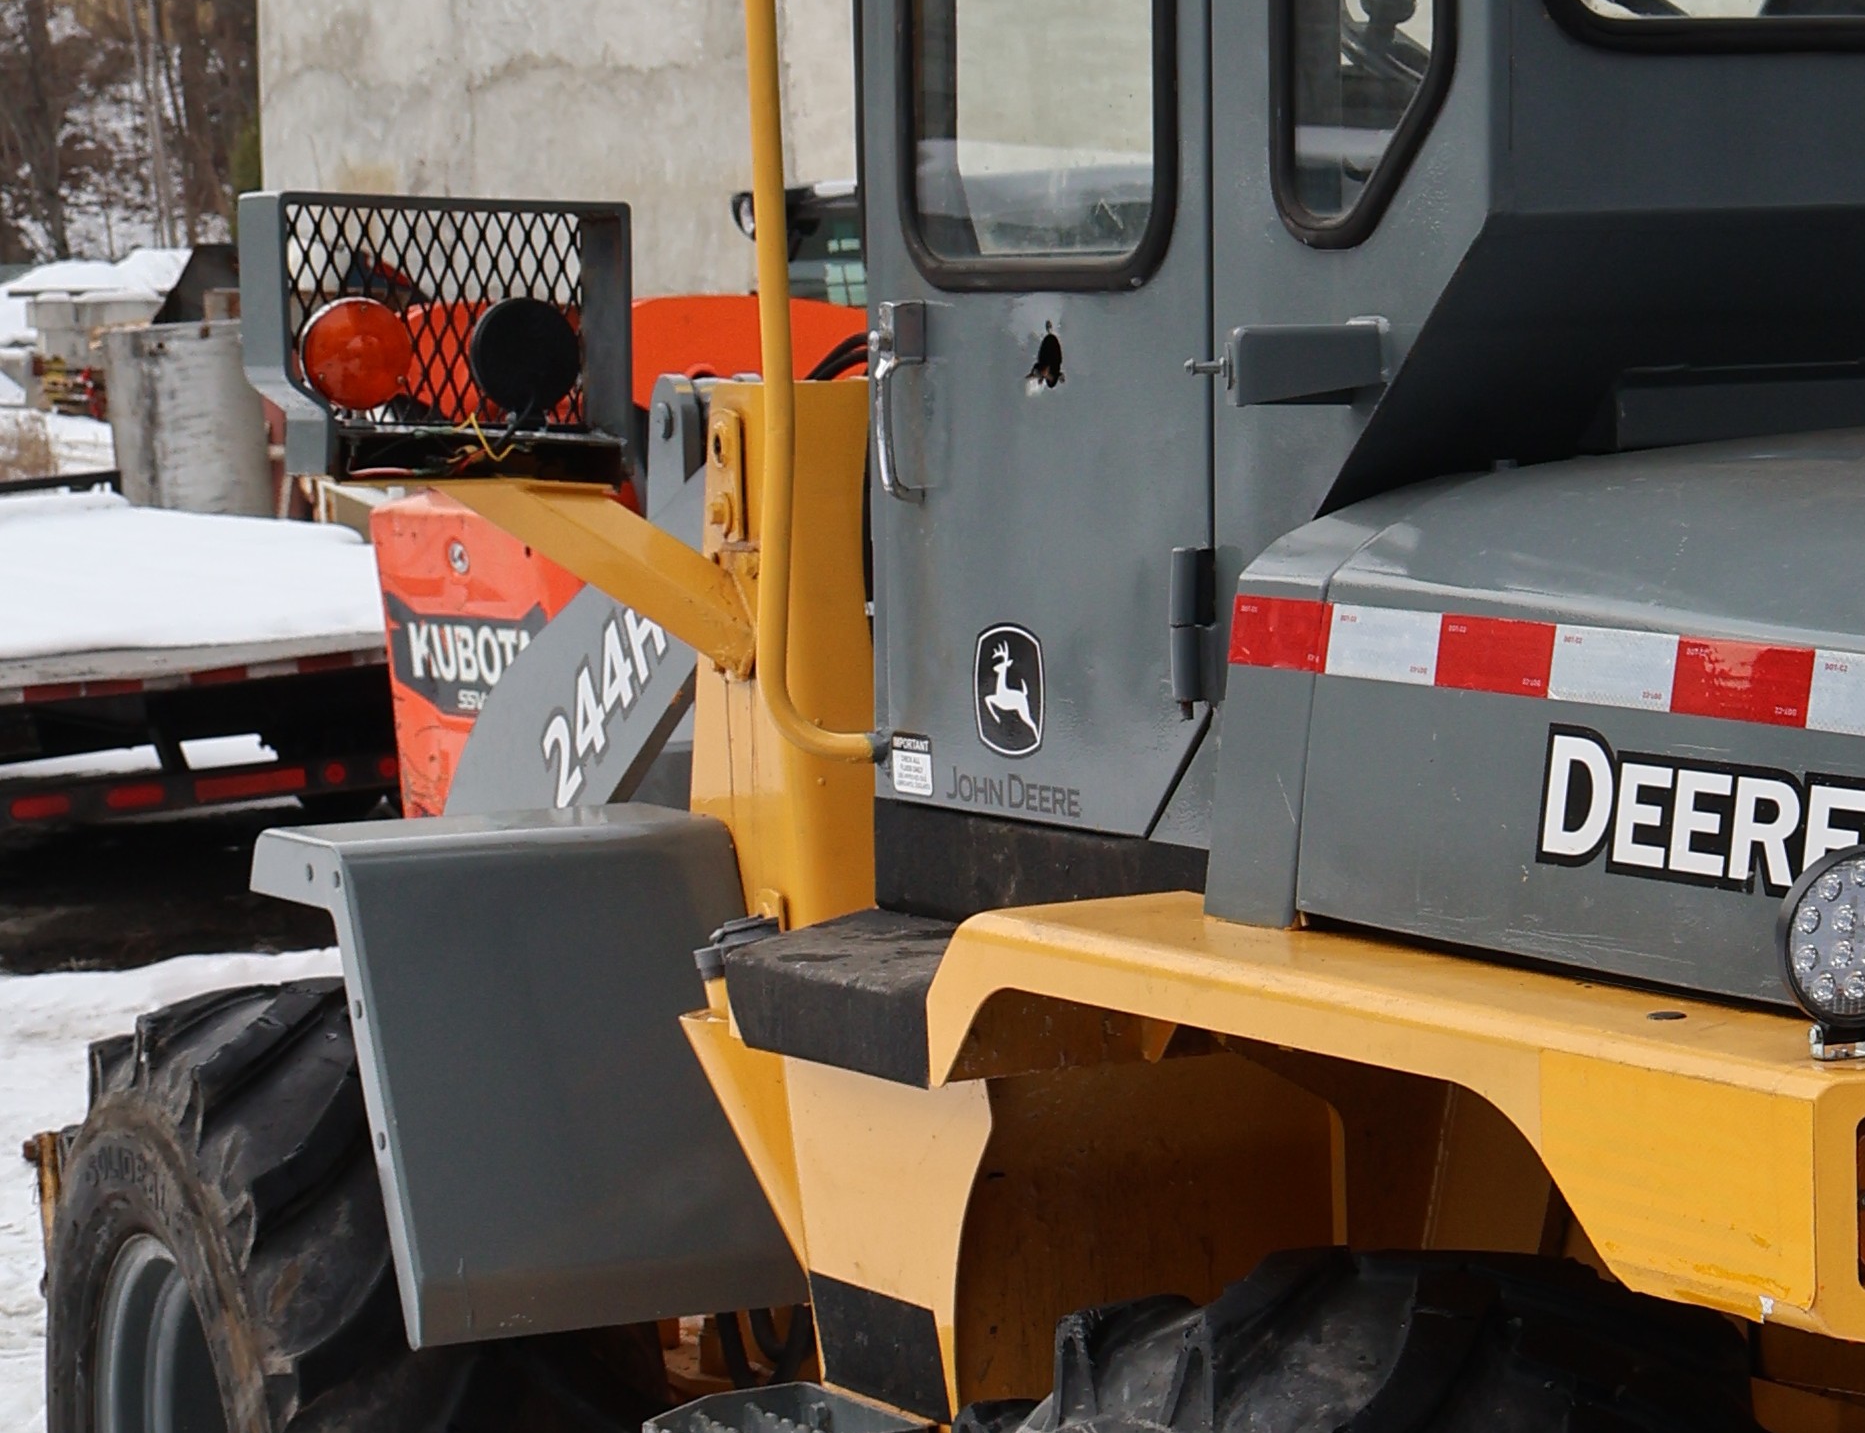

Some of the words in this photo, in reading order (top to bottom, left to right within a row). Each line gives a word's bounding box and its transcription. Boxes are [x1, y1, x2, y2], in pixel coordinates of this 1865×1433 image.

[408, 621, 530, 686] KUBOT
[1824, 663, 1848, 673] DOT-C2
[543, 607, 666, 809] 244H
[947, 766, 1004, 807] JOHN
[1008, 773, 1081, 818] DEERE
